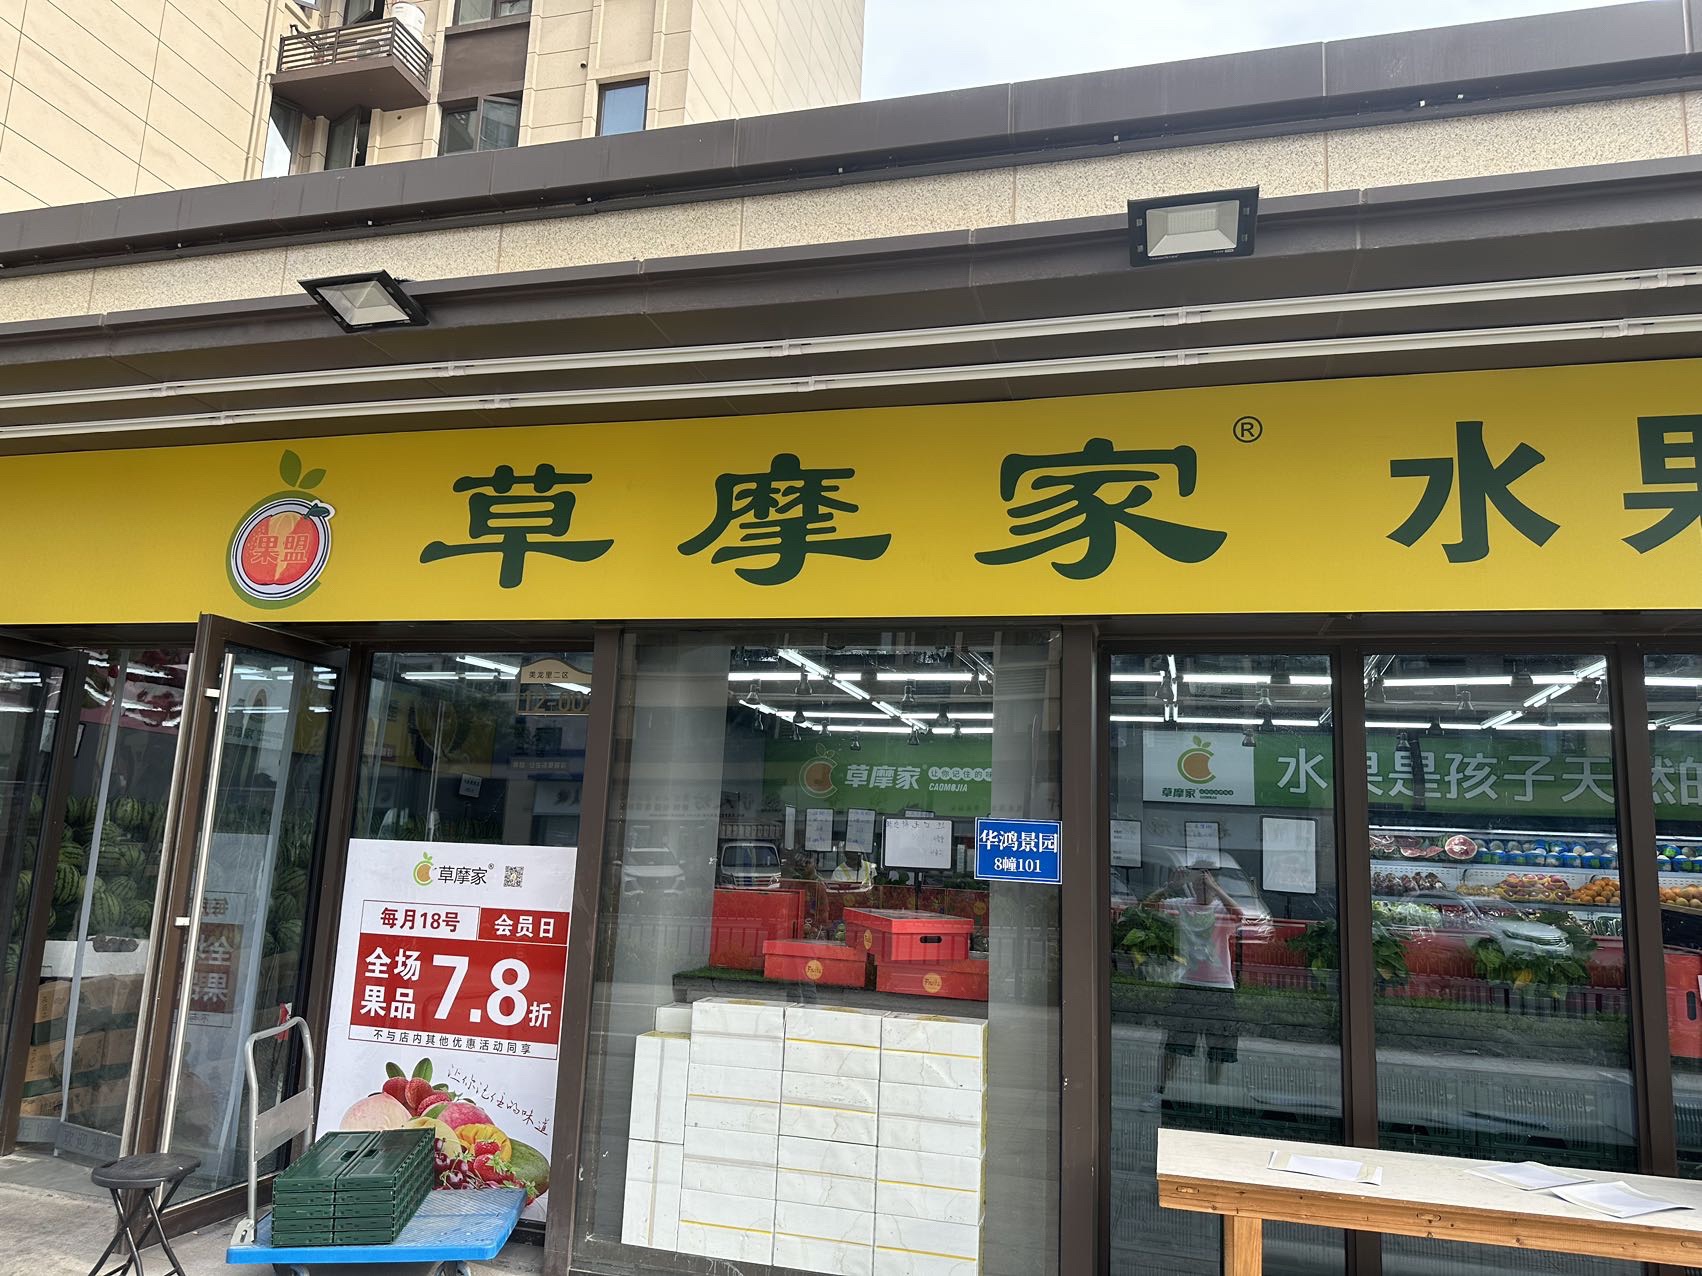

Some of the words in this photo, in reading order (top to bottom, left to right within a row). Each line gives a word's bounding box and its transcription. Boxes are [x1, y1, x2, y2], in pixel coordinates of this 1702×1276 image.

[420, 437, 1227, 590] 草摩家
[844, 764, 922, 790] 草摩家
[979, 829, 1058, 853] 华鸿景园
[437, 865, 488, 885] 草摩家
[993, 856, 1042, 873] 8幢101
[380, 907, 460, 932] 每月18号
[494, 914, 555, 938] 会员日
[364, 946, 422, 981] 全场
[360, 985, 416, 1020] 果品
[373, 1029, 531, 1055] 不与店内其他优惠活动同享
[447, 1064, 550, 1136] 让你记住的味道
